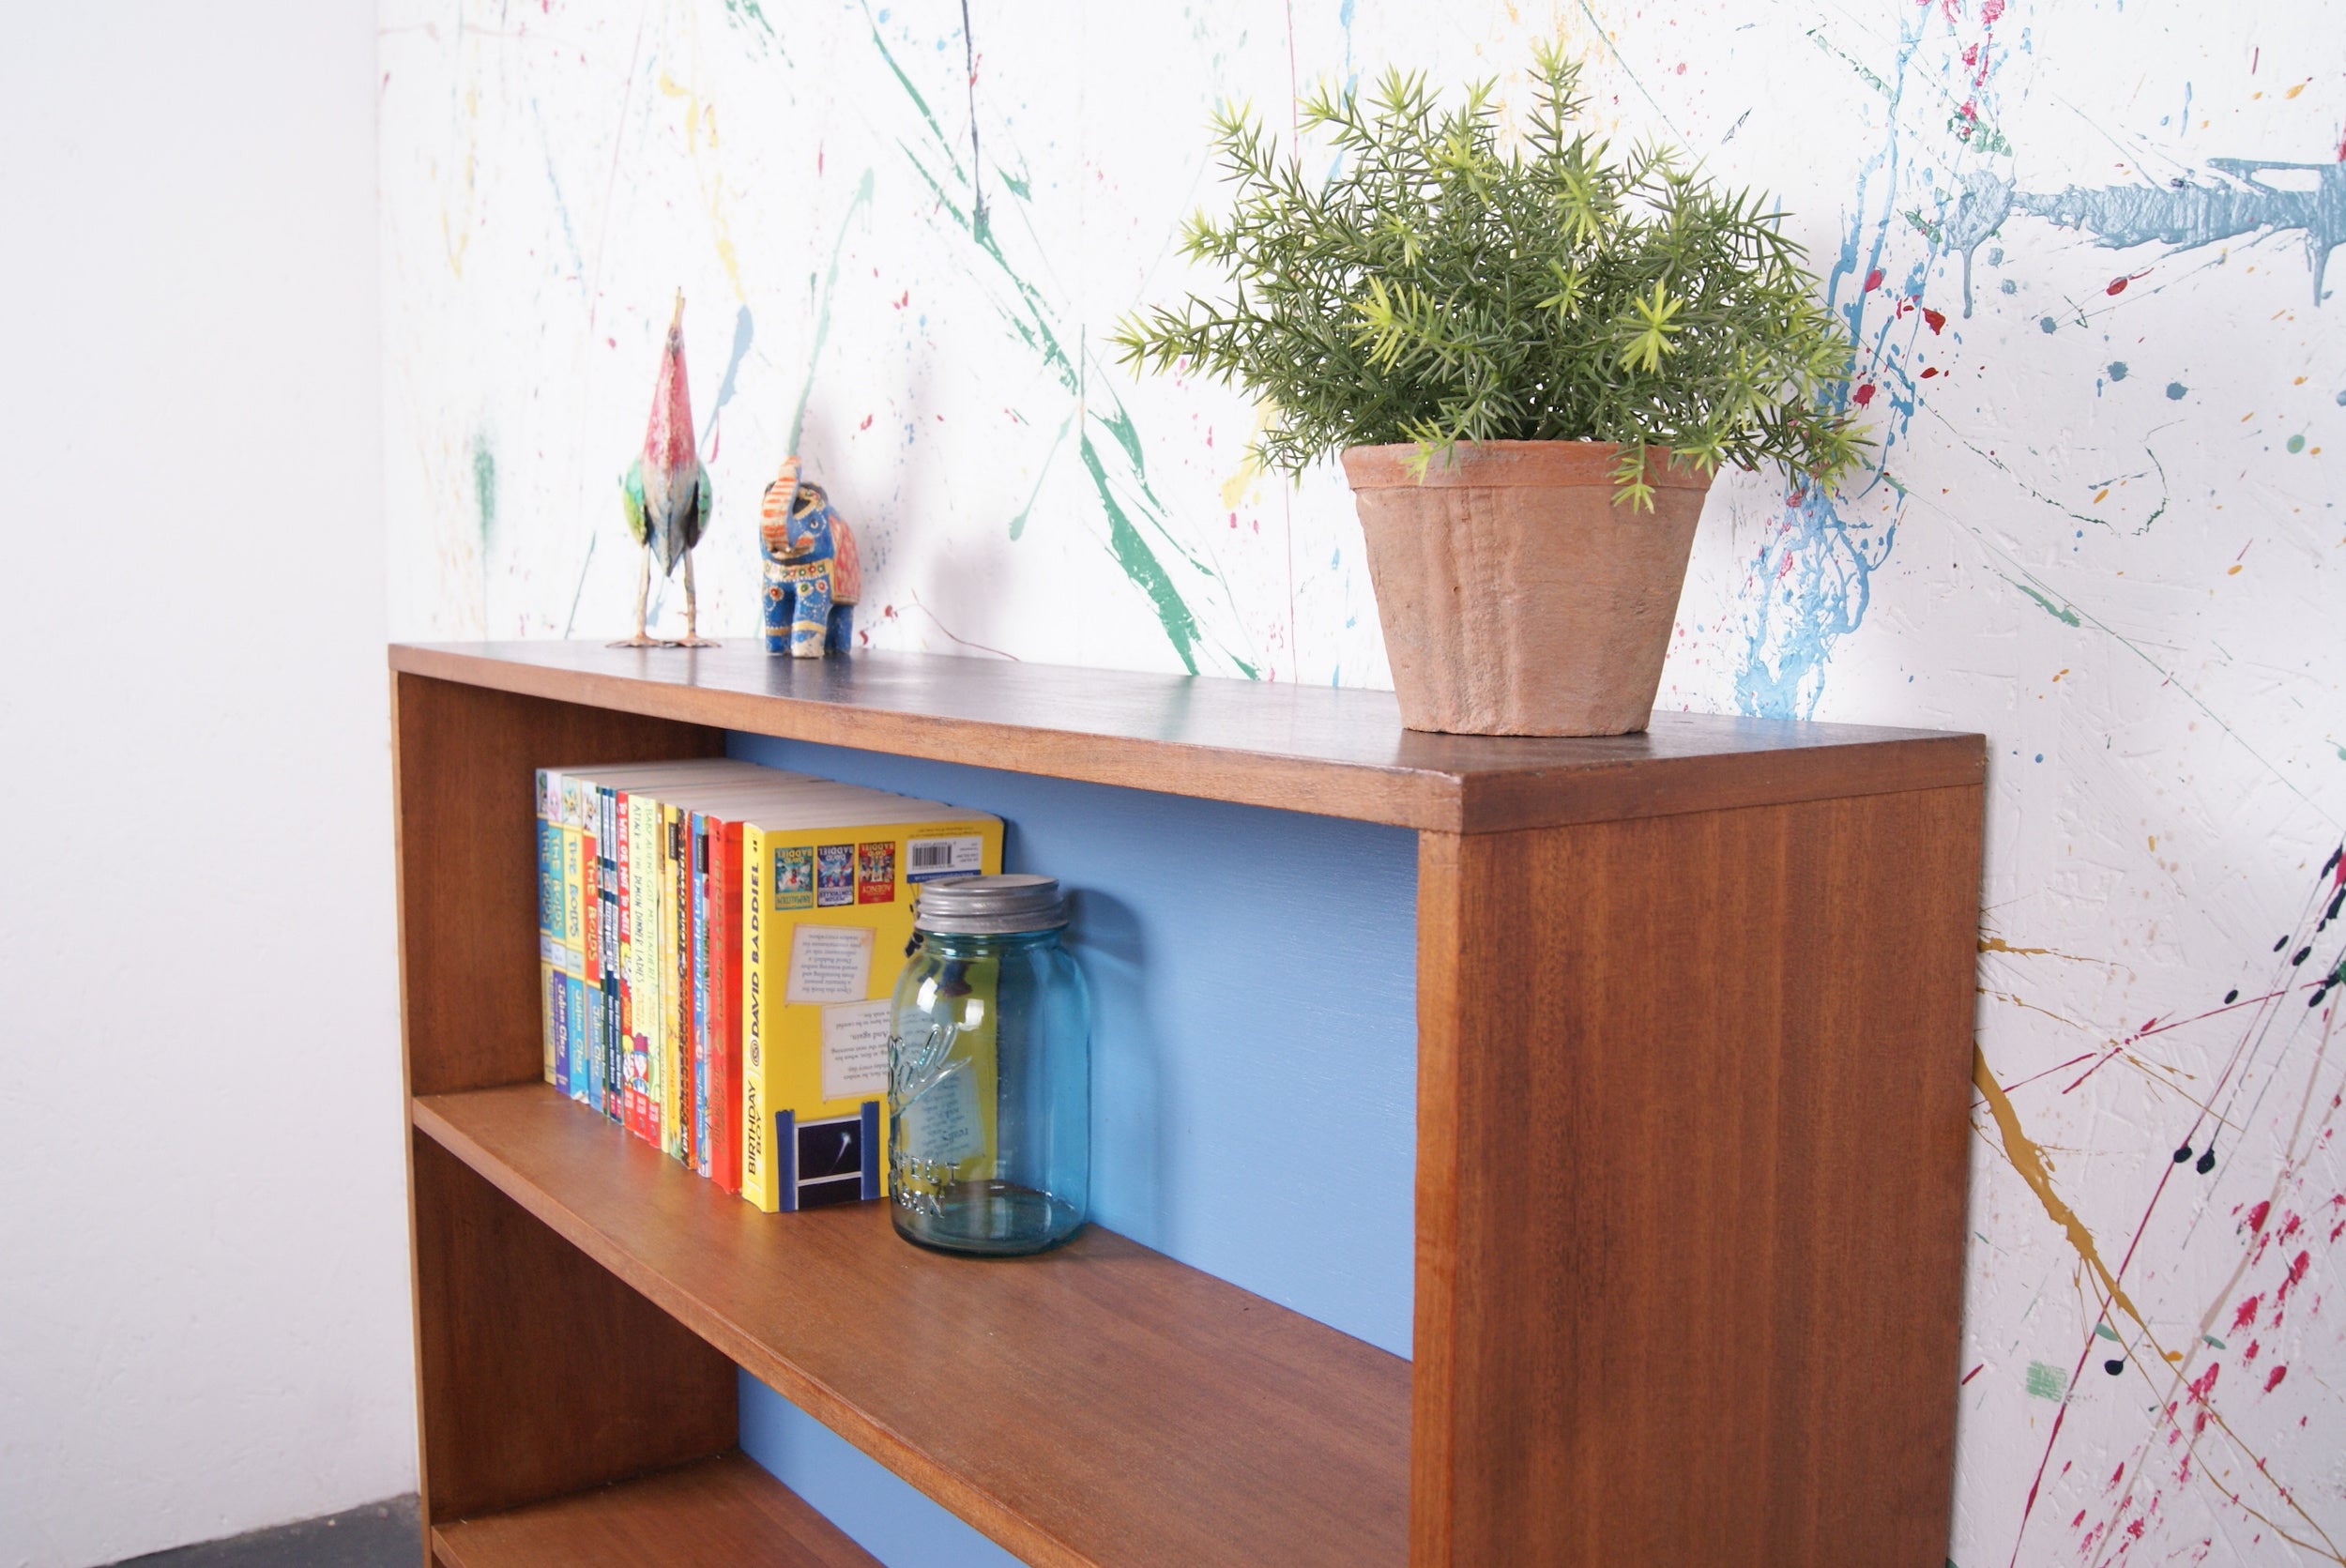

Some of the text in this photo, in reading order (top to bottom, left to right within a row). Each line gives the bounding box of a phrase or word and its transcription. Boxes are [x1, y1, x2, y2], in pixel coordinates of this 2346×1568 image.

[619, 817, 629, 841] WEE
[633, 804, 642, 838] ATTACK
[541, 830, 551, 864] THE
[619, 845, 629, 862] OR
[552, 836, 563, 930] THE BOLDS
[569, 837, 580, 938] THE BOLDS
[620, 865, 630, 890] NOT
[634, 875, 643, 909] DEMON
[646, 879, 655, 903] GOT
[861, 884, 891, 893] AGENCY
[586, 856, 598, 962] THE BOLDS
[634, 911, 645, 946] DINNER
[635, 949, 645, 983] LADIES
[751, 862, 759, 1038] DAVID BADDIEL
[557, 982, 567, 1023] Julian
[559, 1024, 568, 1058] Clary
[592, 1005, 602, 1046] Julian
[873, 1031, 888, 1040] And
[575, 1038, 584, 1074] Clary
[593, 1045, 602, 1078] Clary
[748, 1079, 756, 1176] BIRTHDAY
